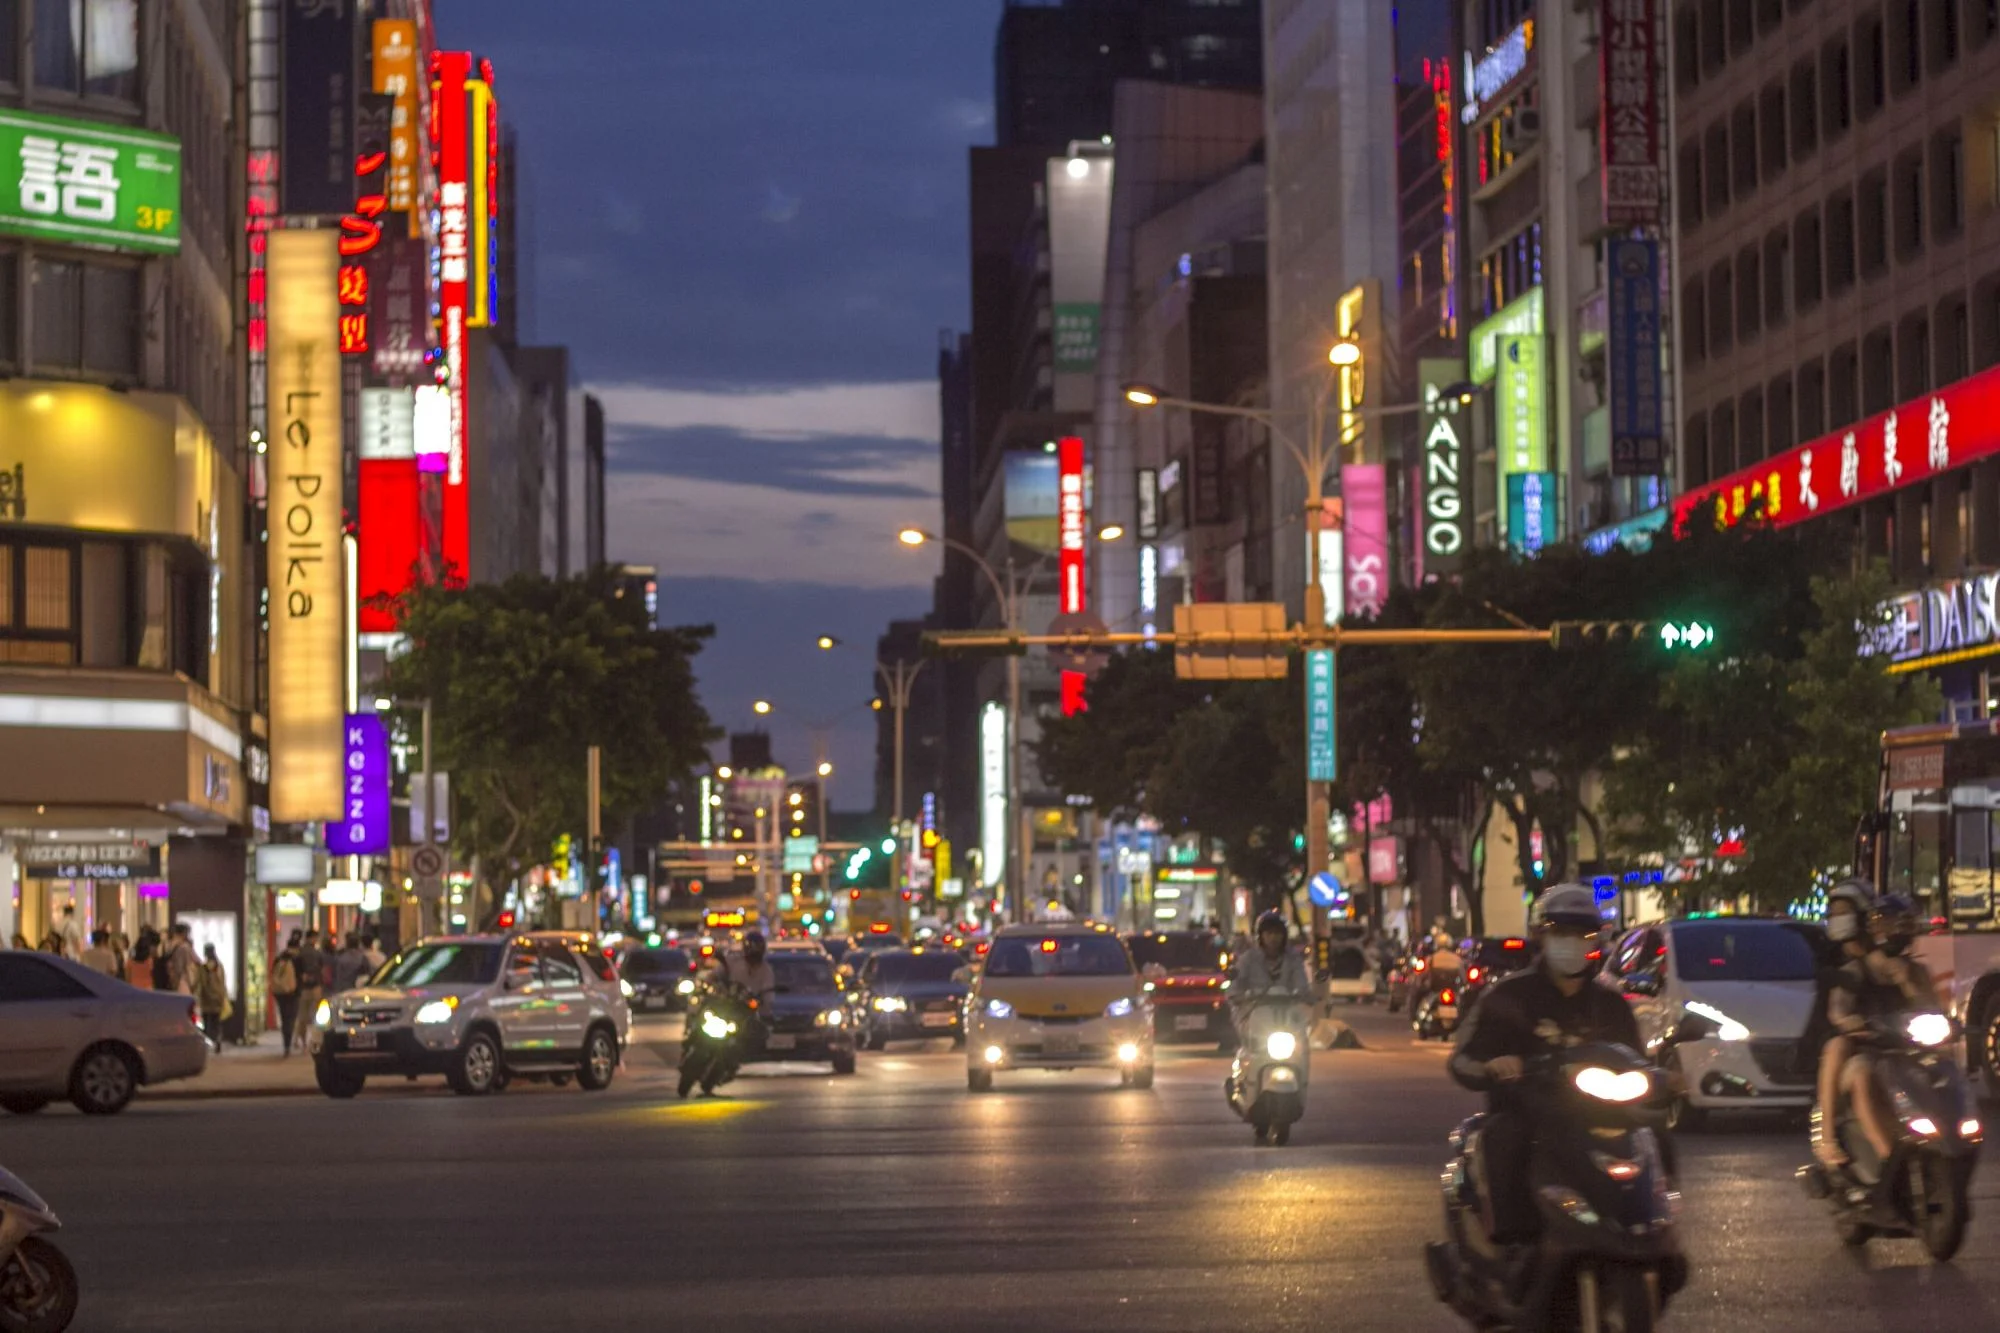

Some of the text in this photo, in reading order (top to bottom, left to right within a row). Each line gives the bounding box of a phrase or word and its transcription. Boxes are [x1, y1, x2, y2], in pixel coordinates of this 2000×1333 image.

[19, 135, 121, 222] 語
[136, 206, 174, 231] 3F
[286, 391, 324, 620] Le Polka
